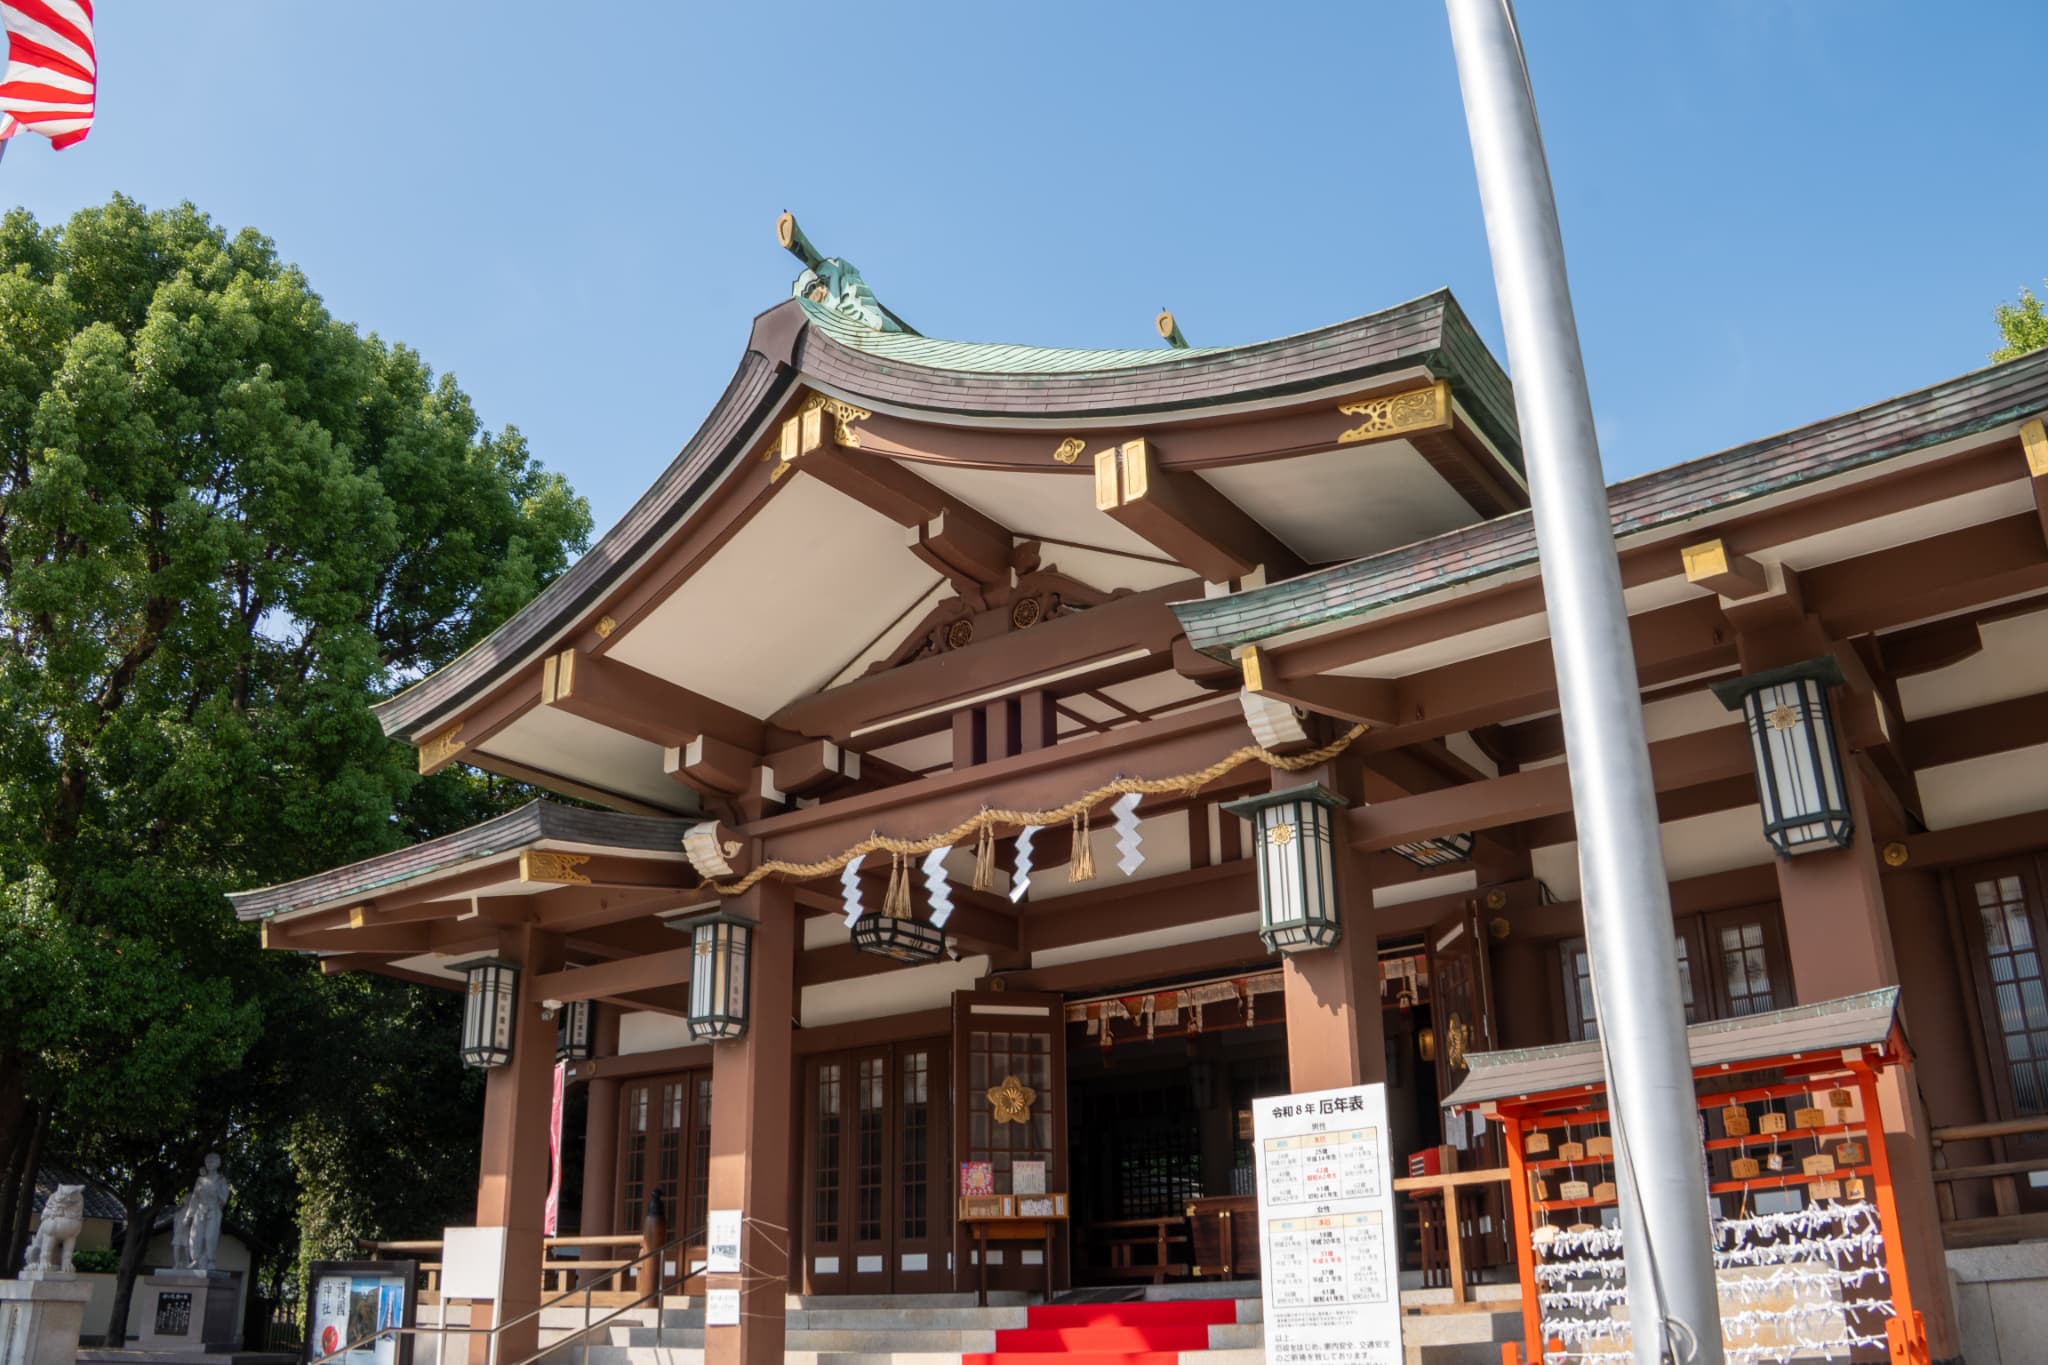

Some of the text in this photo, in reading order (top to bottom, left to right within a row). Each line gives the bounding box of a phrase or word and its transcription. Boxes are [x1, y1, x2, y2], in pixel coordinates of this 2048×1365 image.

[1272, 1095, 1364, 1119] 令和8年 厄年表
[1311, 1122, 1326, 1131] 男性
[1317, 1205, 1330, 1213] 女性
